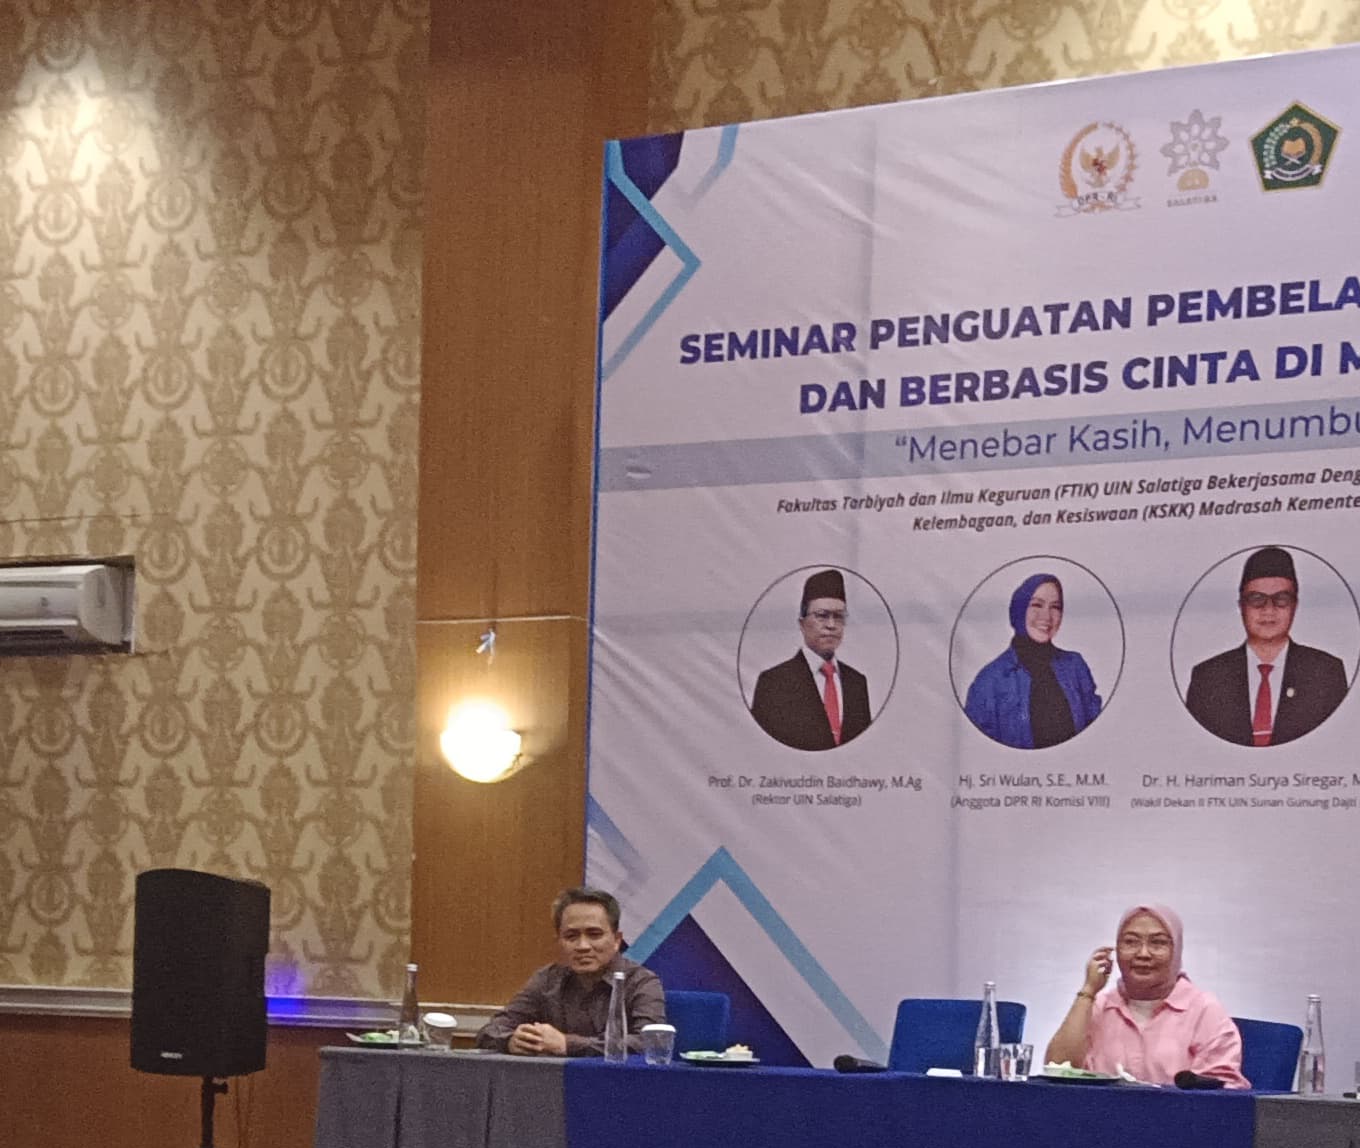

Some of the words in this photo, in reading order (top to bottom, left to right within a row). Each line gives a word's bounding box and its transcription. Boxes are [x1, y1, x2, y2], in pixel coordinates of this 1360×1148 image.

[680, 323, 856, 364] SEMINAR
[869, 297, 1131, 349] PENGUATAN
[800, 379, 885, 414] DAN
[899, 361, 1107, 407] BERBASIS
[1122, 347, 1261, 391] CINTA
[1275, 344, 1322, 379] DI
[1068, 423, 1170, 455] Kasih,
[777, 499, 837, 514] Fakultas
[842, 494, 905, 513] Tarbiyah
[909, 492, 936, 508] dan
[941, 489, 974, 506] Ilmu
[978, 486, 1051, 506] Keguruan
[1054, 482, 1099, 500] (FTIK)
[1104, 479, 1133, 496] UIN
[1137, 475, 1203, 496] Salatiga
[1207, 468, 1315, 491] Bekerjasama
[912, 512, 1018, 533] Kelembagaan,
[1022, 508, 1052, 526] dan
[1056, 503, 1139, 524] Kesiswaan
[1143, 502, 1196, 521] (KSKK)
[1199, 498, 1283, 517] Madrasah
[1142, 774, 1162, 788] Dr.
[1166, 774, 1180, 788] H.
[1184, 774, 1245, 788] Hariman
[1248, 773, 1290, 790] Surya
[1292, 773, 1348, 790] Siregar,
[950, 795, 1000, 809] (Anggota
[1003, 796, 1028, 808] DPR
[1031, 796, 1042, 807] RI
[1045, 795, 1084, 807] Komisi
[1087, 795, 1111, 808] VIII)
